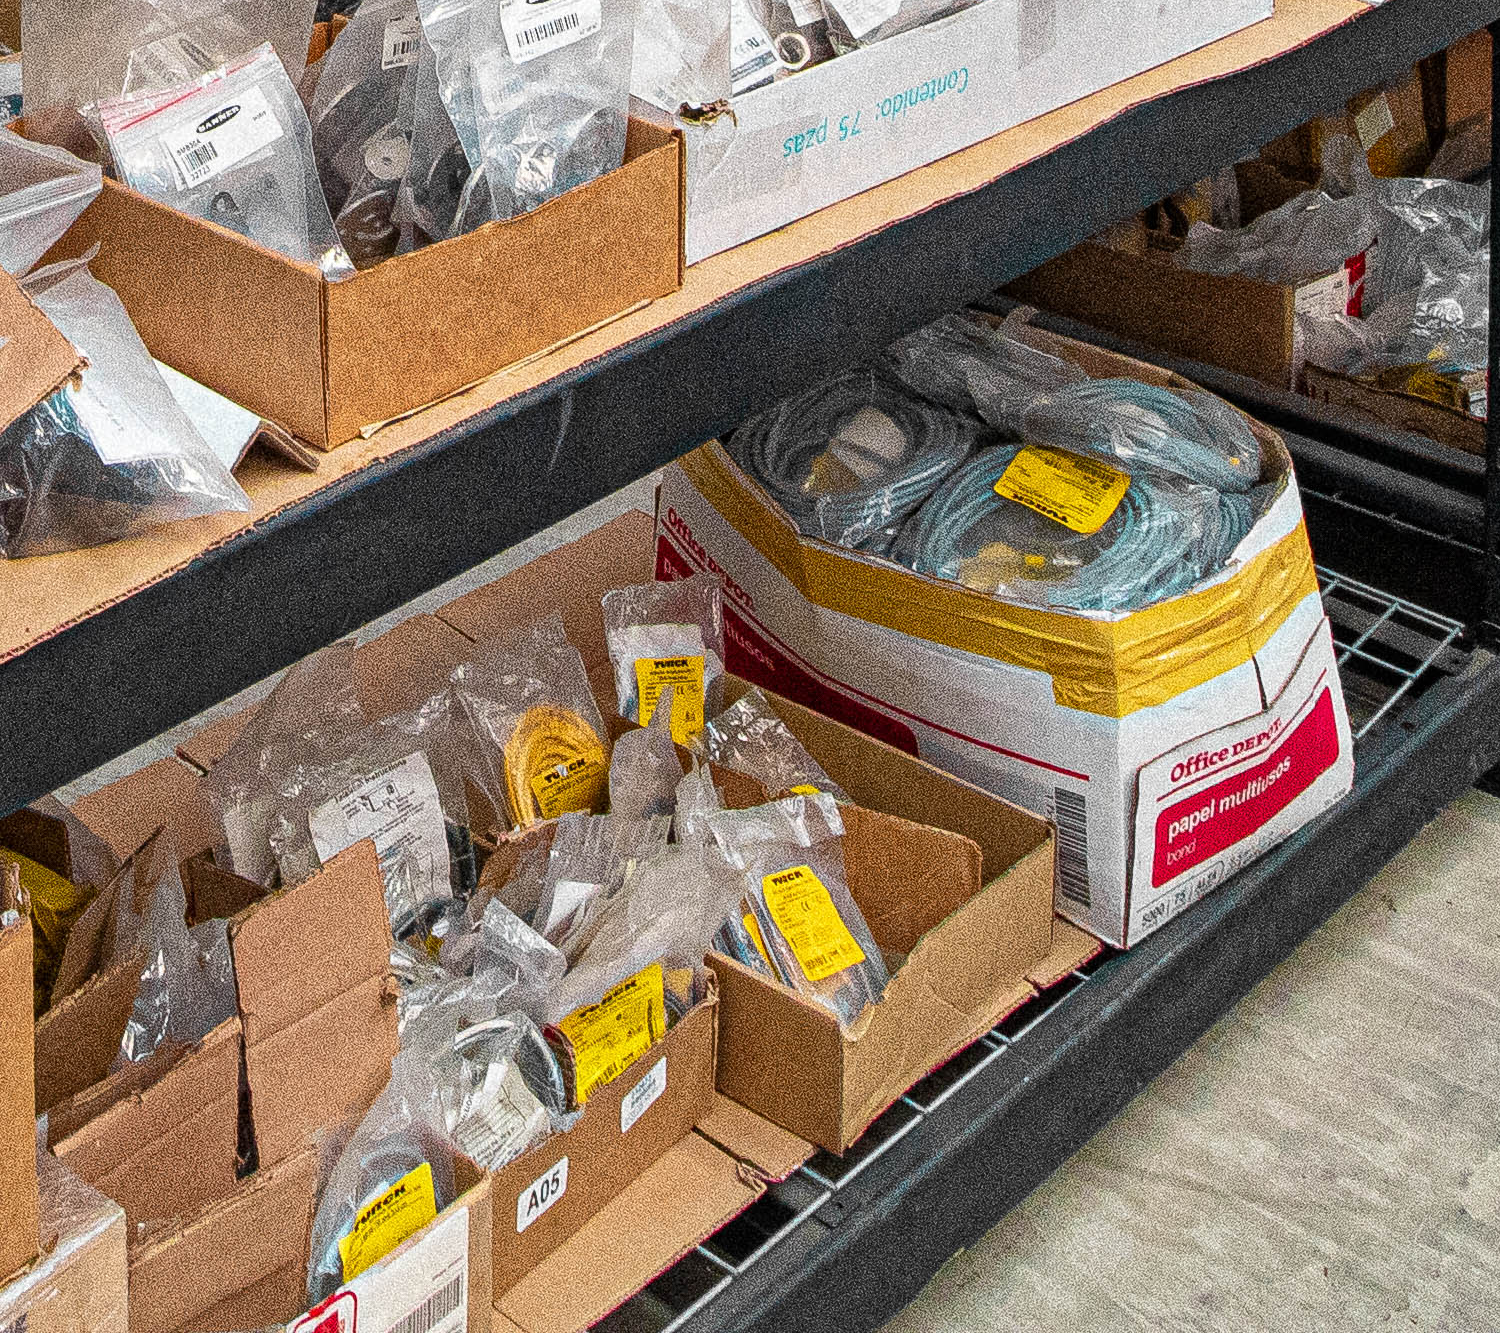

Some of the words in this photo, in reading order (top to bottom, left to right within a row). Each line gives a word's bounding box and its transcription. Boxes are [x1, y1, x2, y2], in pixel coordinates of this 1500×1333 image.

[875, 65, 969, 128] Contenido:
[196, 105, 241, 135] BANNER
[782, 119, 830, 159] pzas
[838, 110, 862, 142] 75
[1169, 749, 1230, 784] Office
[1231, 720, 1282, 763] DEPOT
[1165, 803, 1217, 844] papel
[1219, 754, 1294, 823] multiusos
[527, 1168, 562, 1213] A05
